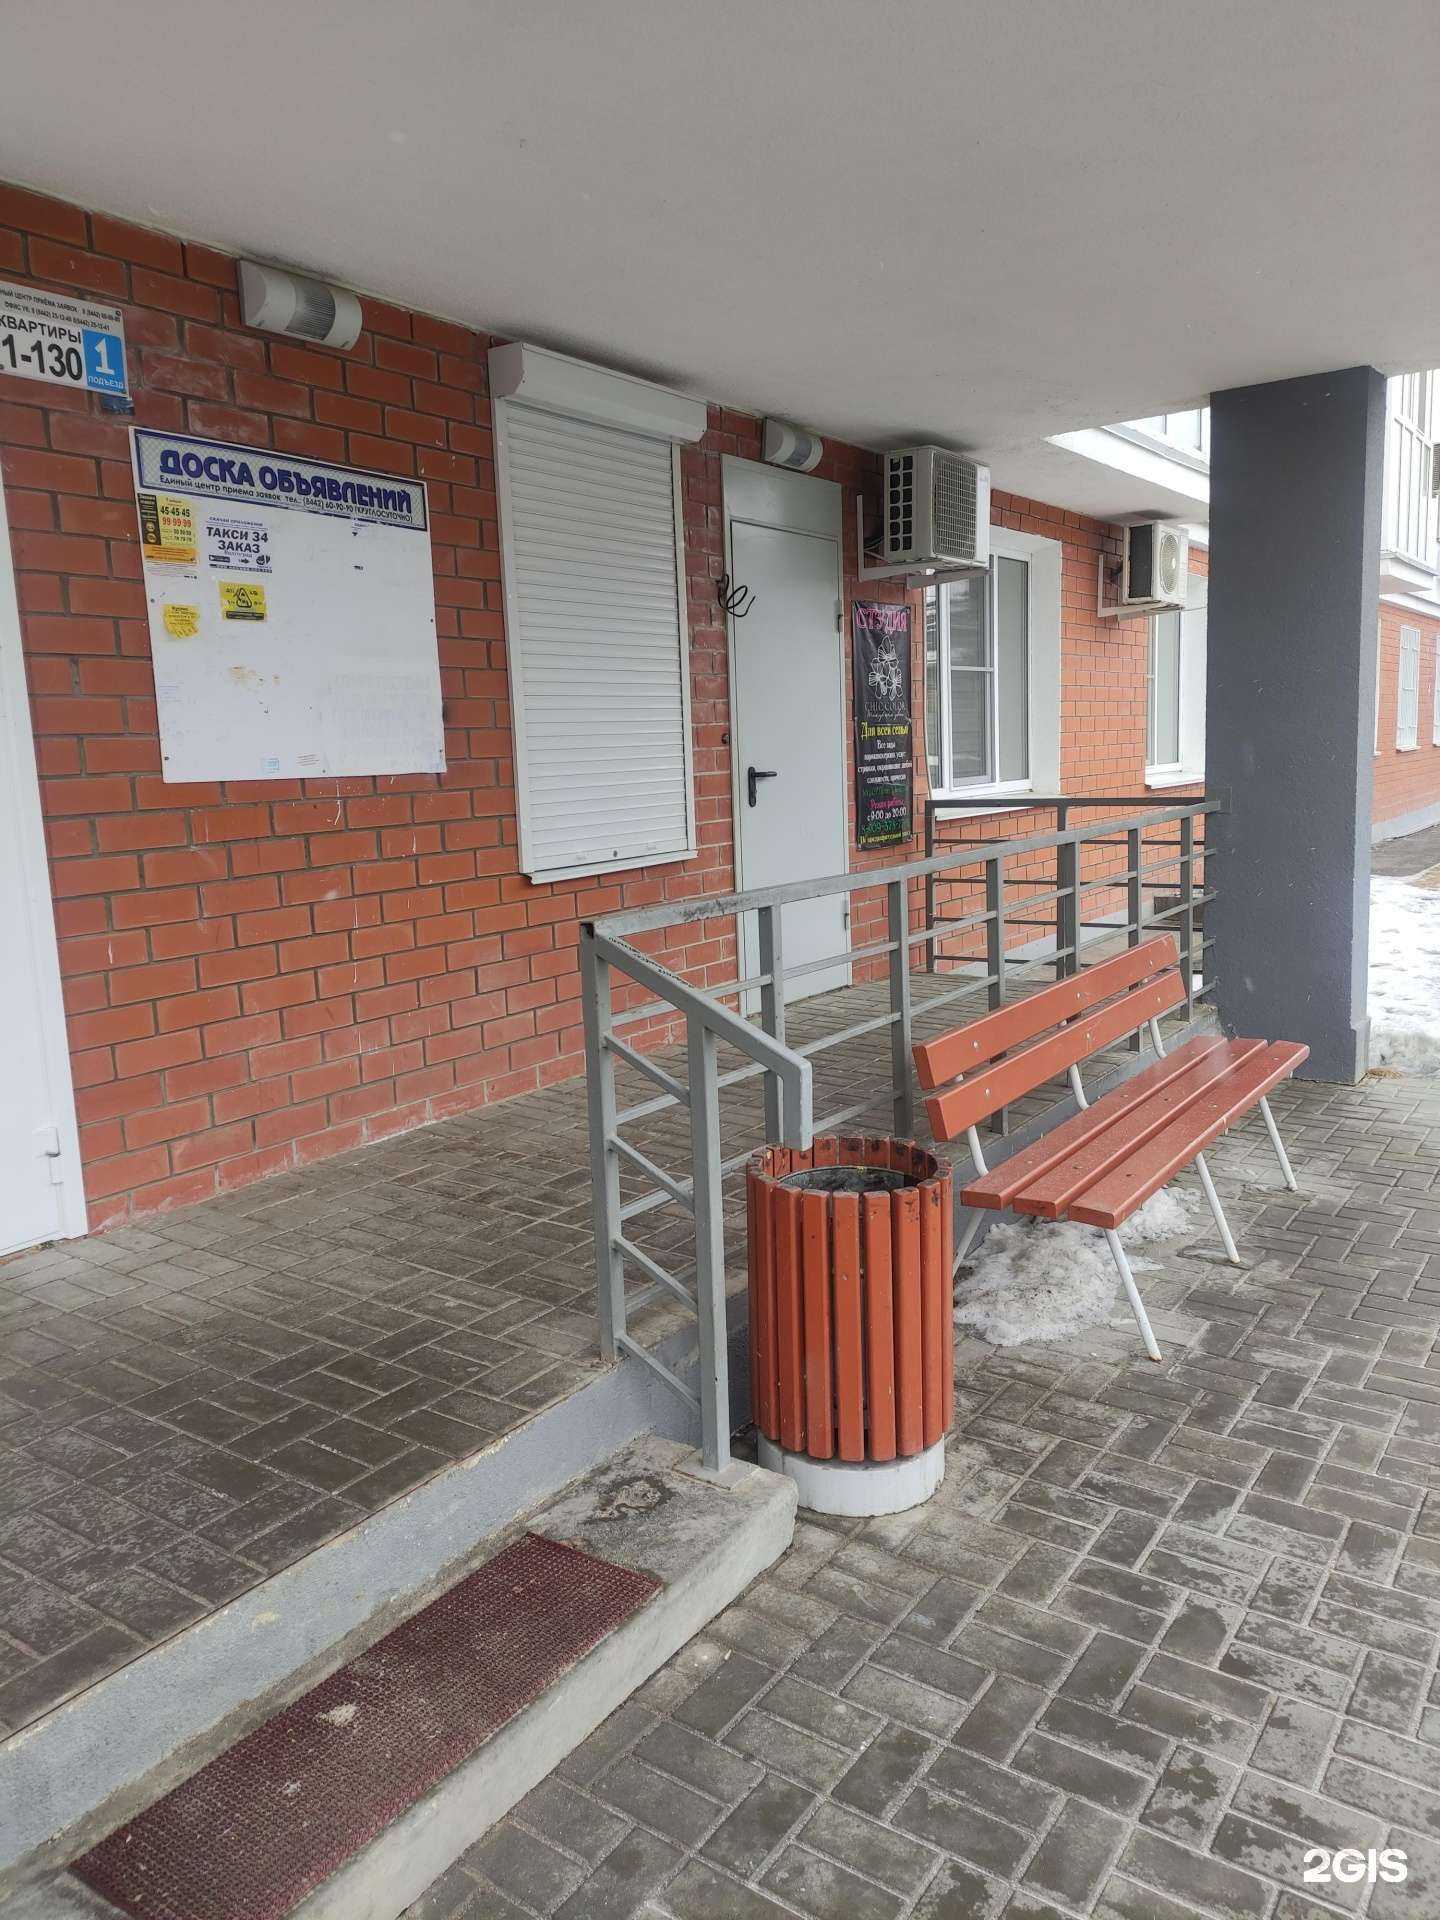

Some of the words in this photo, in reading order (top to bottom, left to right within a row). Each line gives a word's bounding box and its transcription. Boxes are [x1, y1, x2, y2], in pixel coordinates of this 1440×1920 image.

[0, 314, 82, 344] КВАРТИРЫ
[0, 333, 83, 381] 1-130
[94, 337, 115, 376] 1
[88, 375, 124, 390] ПОДЪЕЗД
[160, 449, 256, 488] ДОСКА
[259, 465, 412, 514] ОБЪЯВЛЕНИЙ
[160, 474, 193, 488] Единый
[194, 482, 221, 493] центр
[222, 486, 254, 498] приема
[256, 491, 281, 502] заявок
[355, 505, 413, 524] (КРУГЛОСУТОЧНО)
[206, 526, 249, 541] ТАКСИ
[252, 531, 269, 543] 34
[218, 540, 260, 554] ЗАКАЗ
[856, 607, 908, 635] СТУДИЯ
[860, 721, 876, 740] Для
[876, 726, 891, 736] всей
